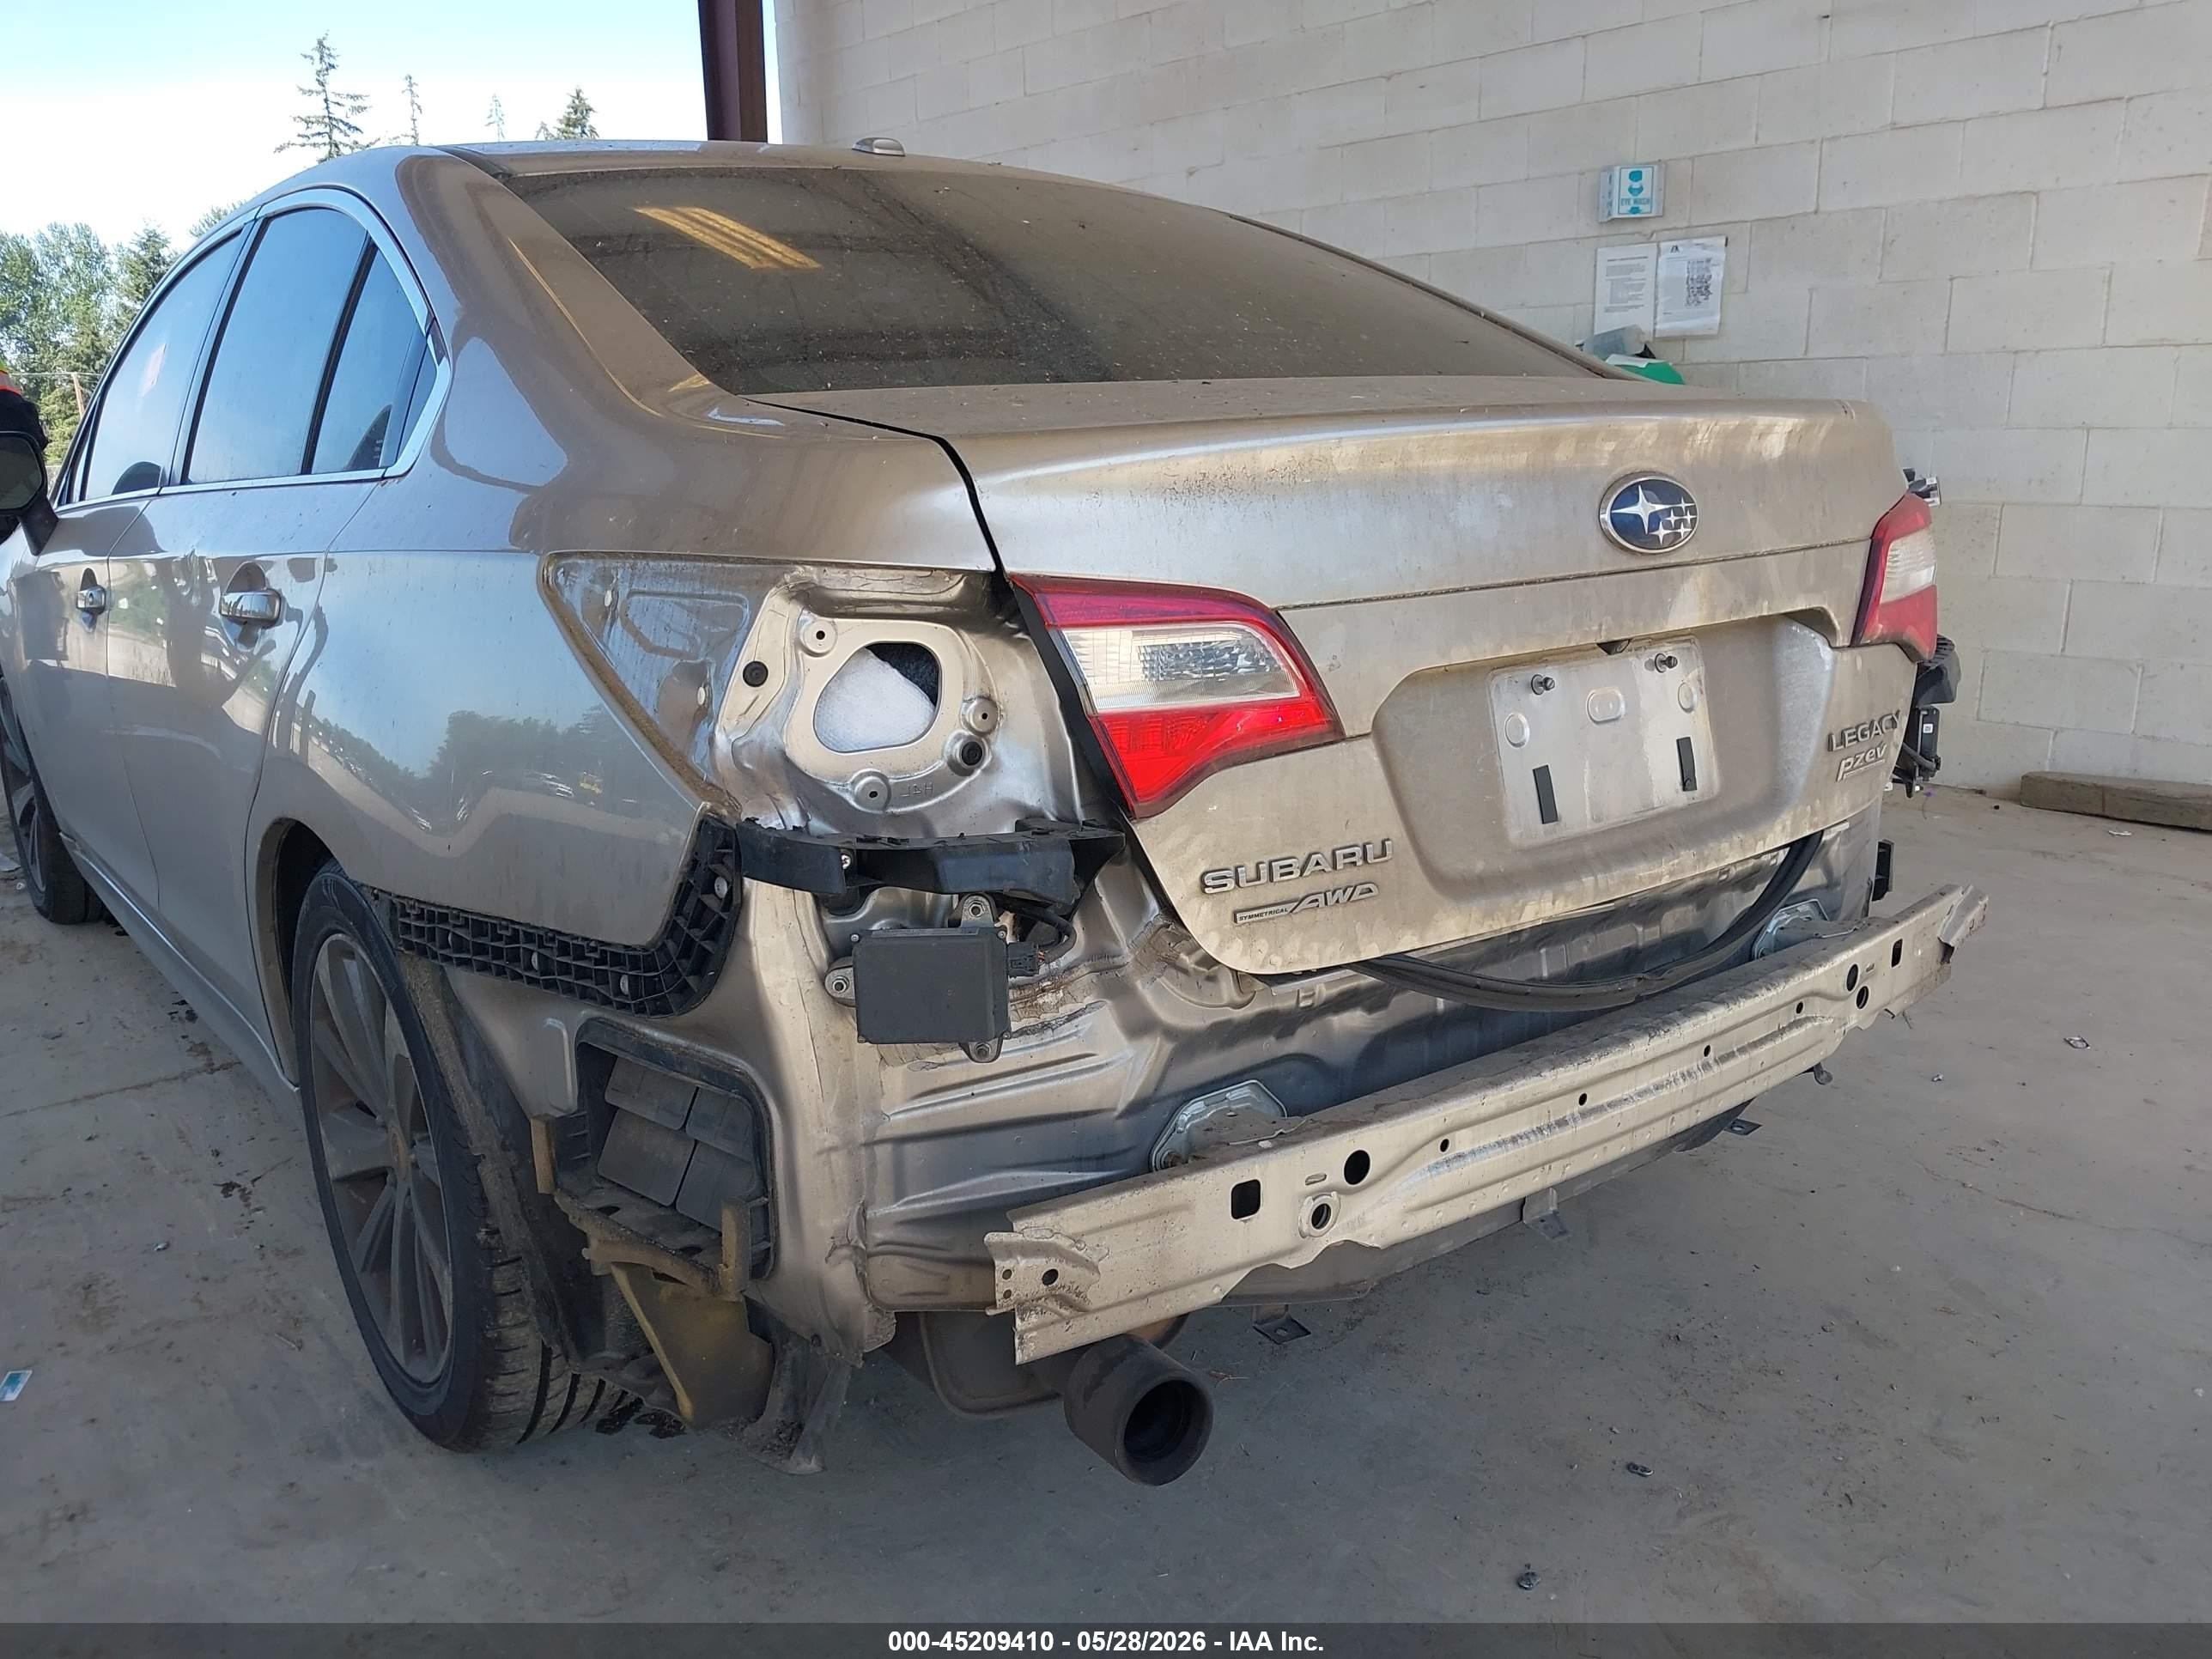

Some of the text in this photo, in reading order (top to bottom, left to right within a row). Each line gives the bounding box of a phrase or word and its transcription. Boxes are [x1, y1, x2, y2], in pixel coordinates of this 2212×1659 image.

[1827, 709, 1900, 751] LEGACY
[1200, 838, 1393, 894] SUBARU
[1238, 883, 1380, 921] SYMMETRICAL AWD
